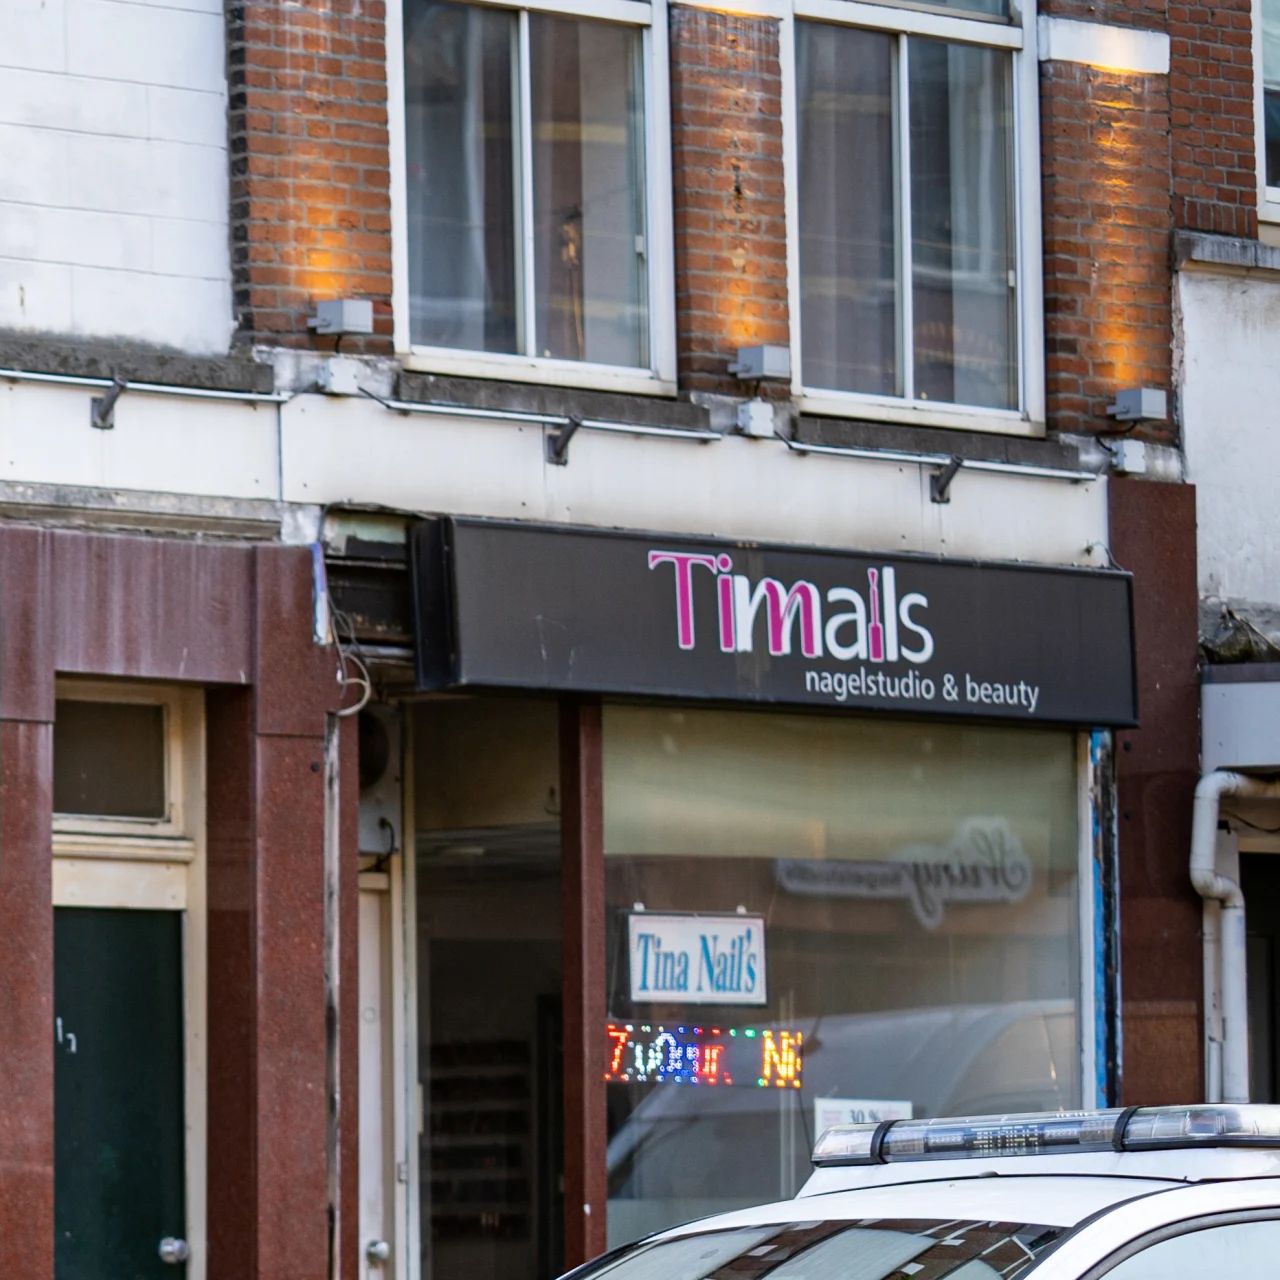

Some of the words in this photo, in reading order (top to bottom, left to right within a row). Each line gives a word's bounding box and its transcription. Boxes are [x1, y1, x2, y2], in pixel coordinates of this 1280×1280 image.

[805, 666, 936, 702] nagelstudio
[942, 674, 959, 702] &
[966, 673, 1039, 713] beauty
[637, 933, 689, 992] Tina
[696, 928, 758, 993] Nail's
